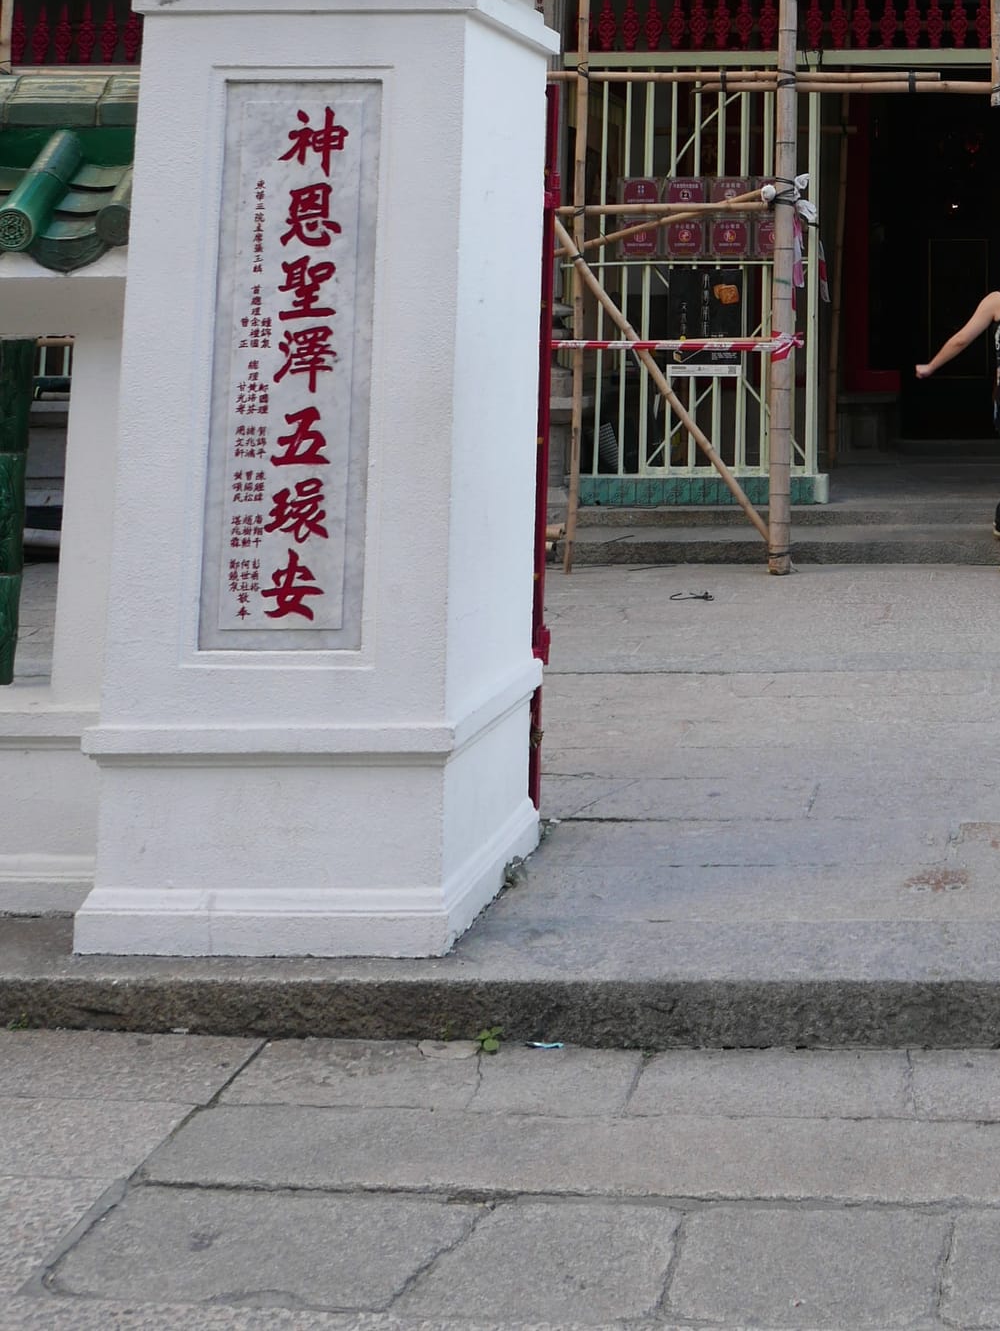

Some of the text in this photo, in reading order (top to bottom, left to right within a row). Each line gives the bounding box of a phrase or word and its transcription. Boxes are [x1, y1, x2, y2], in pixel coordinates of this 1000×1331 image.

[261, 106, 349, 622] 神恩聖澤五環安
